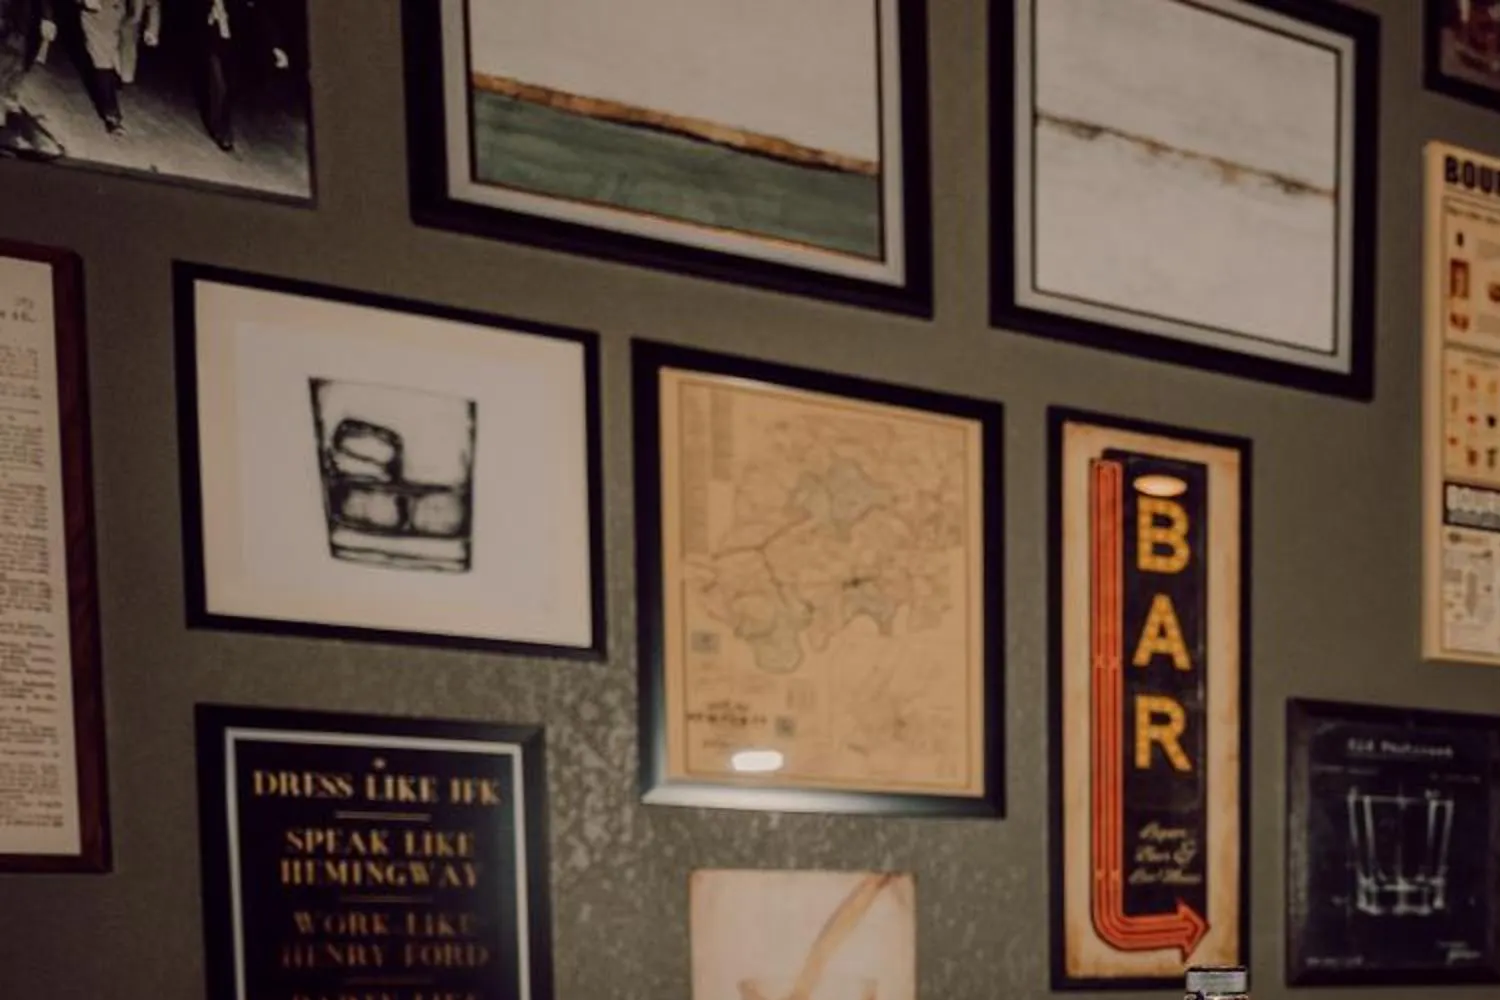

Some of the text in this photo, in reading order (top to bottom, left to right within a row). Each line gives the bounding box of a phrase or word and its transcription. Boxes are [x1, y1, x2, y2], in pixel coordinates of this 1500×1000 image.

[1131, 494, 1193, 773] BAR
[253, 770, 353, 799] DRESS
[365, 775, 440, 803] LIKE
[285, 829, 475, 857] SPEAK LIKE
[280, 860, 480, 888] HEMINGWAY
[294, 910, 480, 937] WORK LIKE
